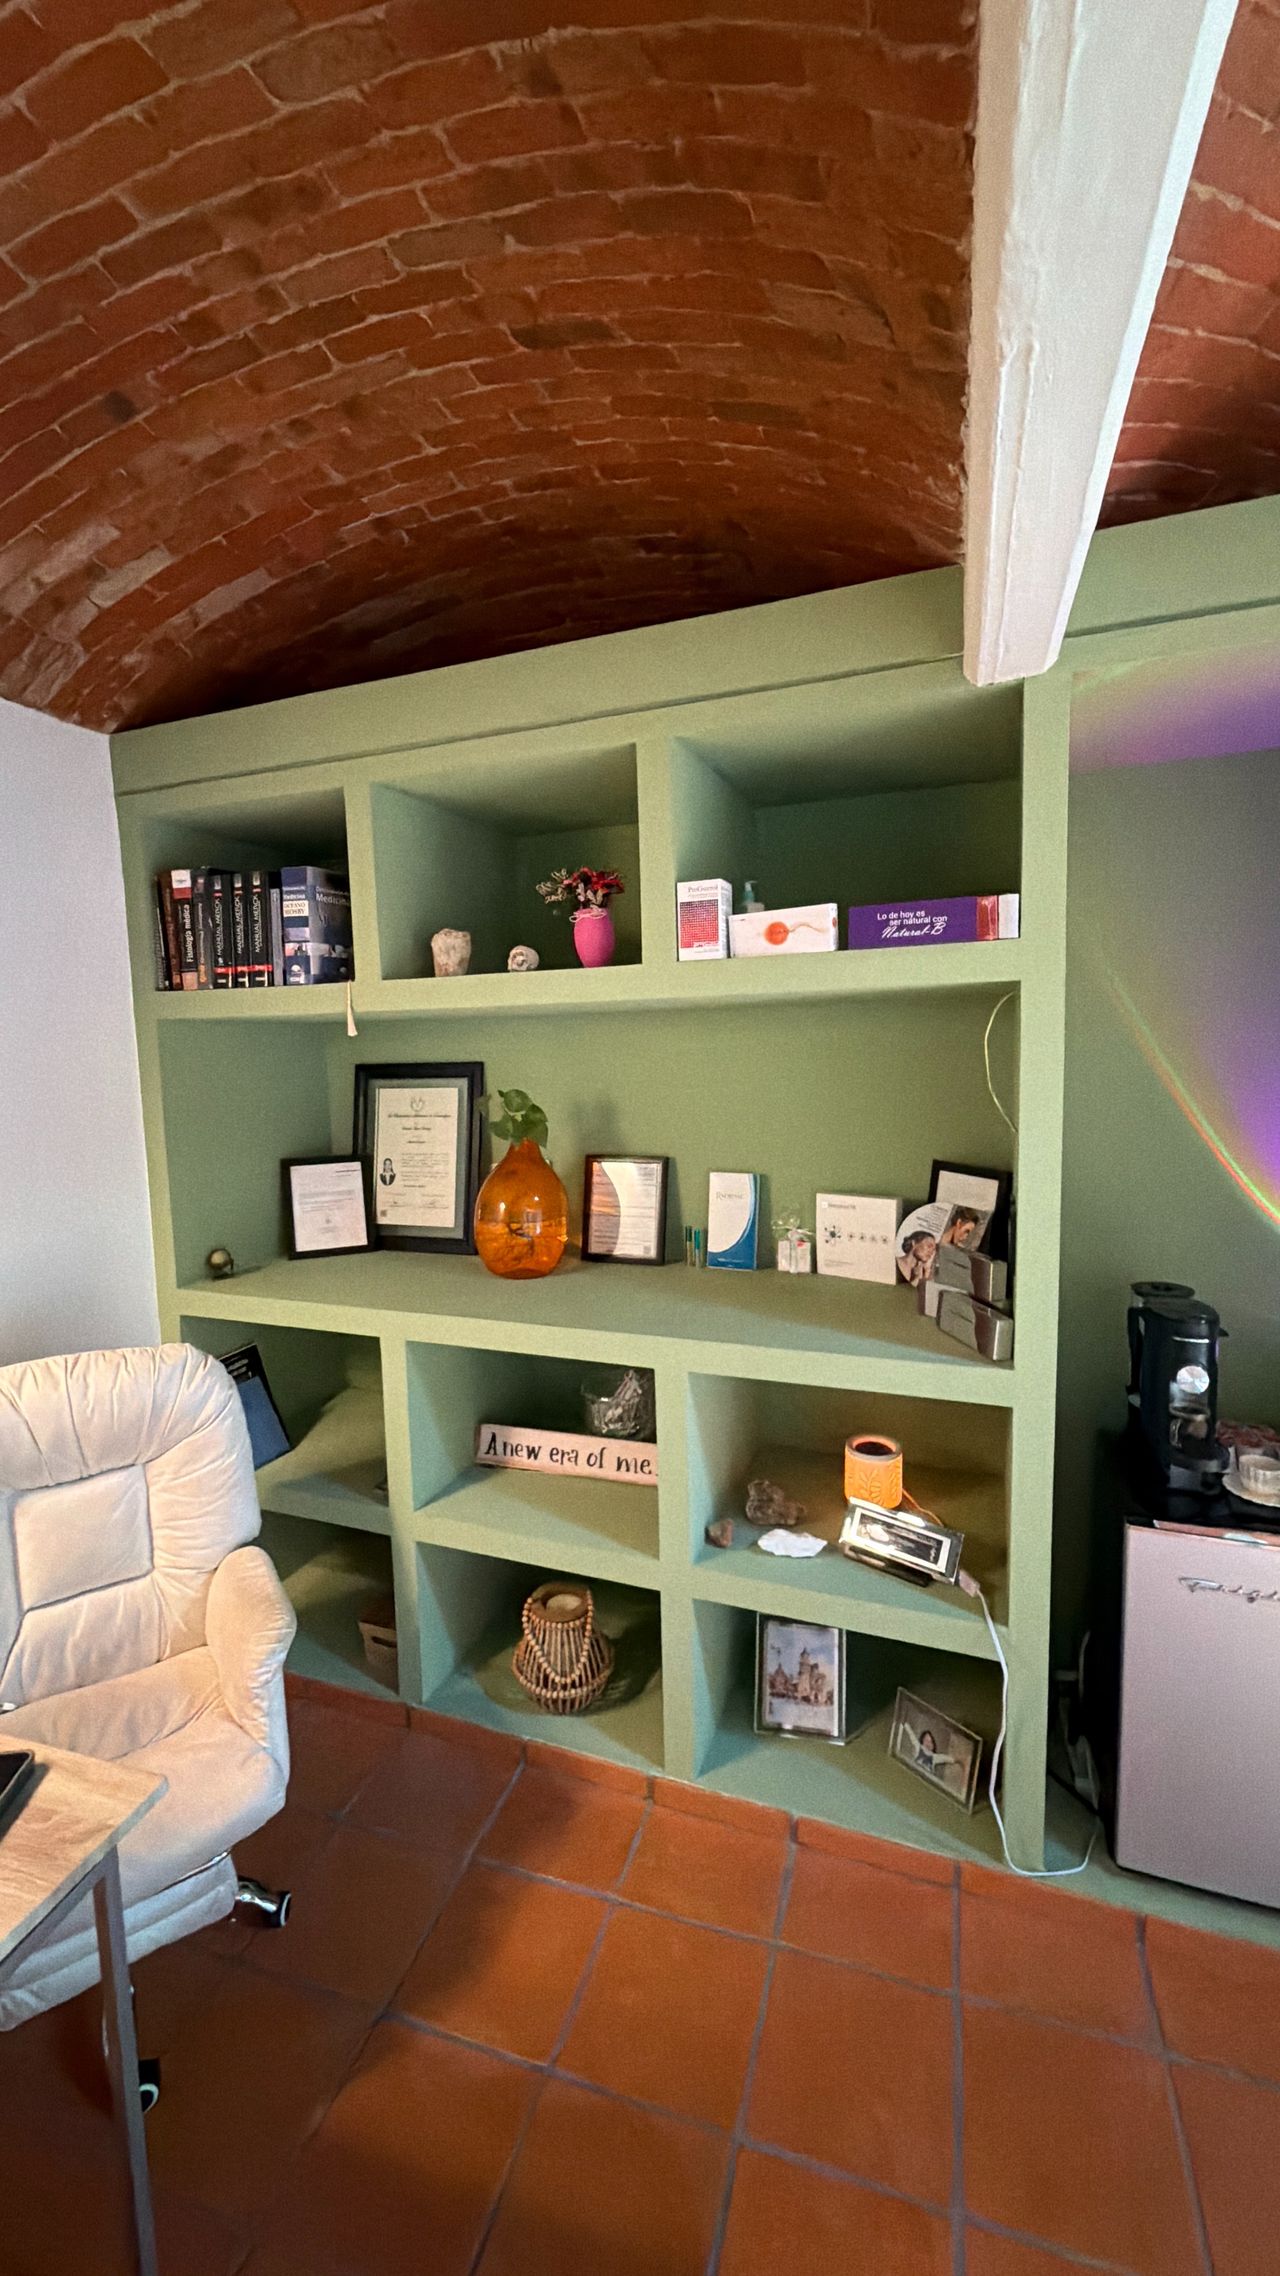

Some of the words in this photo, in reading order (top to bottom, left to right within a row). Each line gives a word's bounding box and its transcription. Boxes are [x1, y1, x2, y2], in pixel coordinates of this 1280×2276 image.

[900, 911, 914, 919] hoy
[903, 916, 931, 925] natural
[881, 922, 946, 939] Natural-B
[484, 1432, 498, 1456] A
[502, 1441, 541, 1461] new
[550, 1447, 578, 1466] era
[586, 1447, 606, 1469] of
